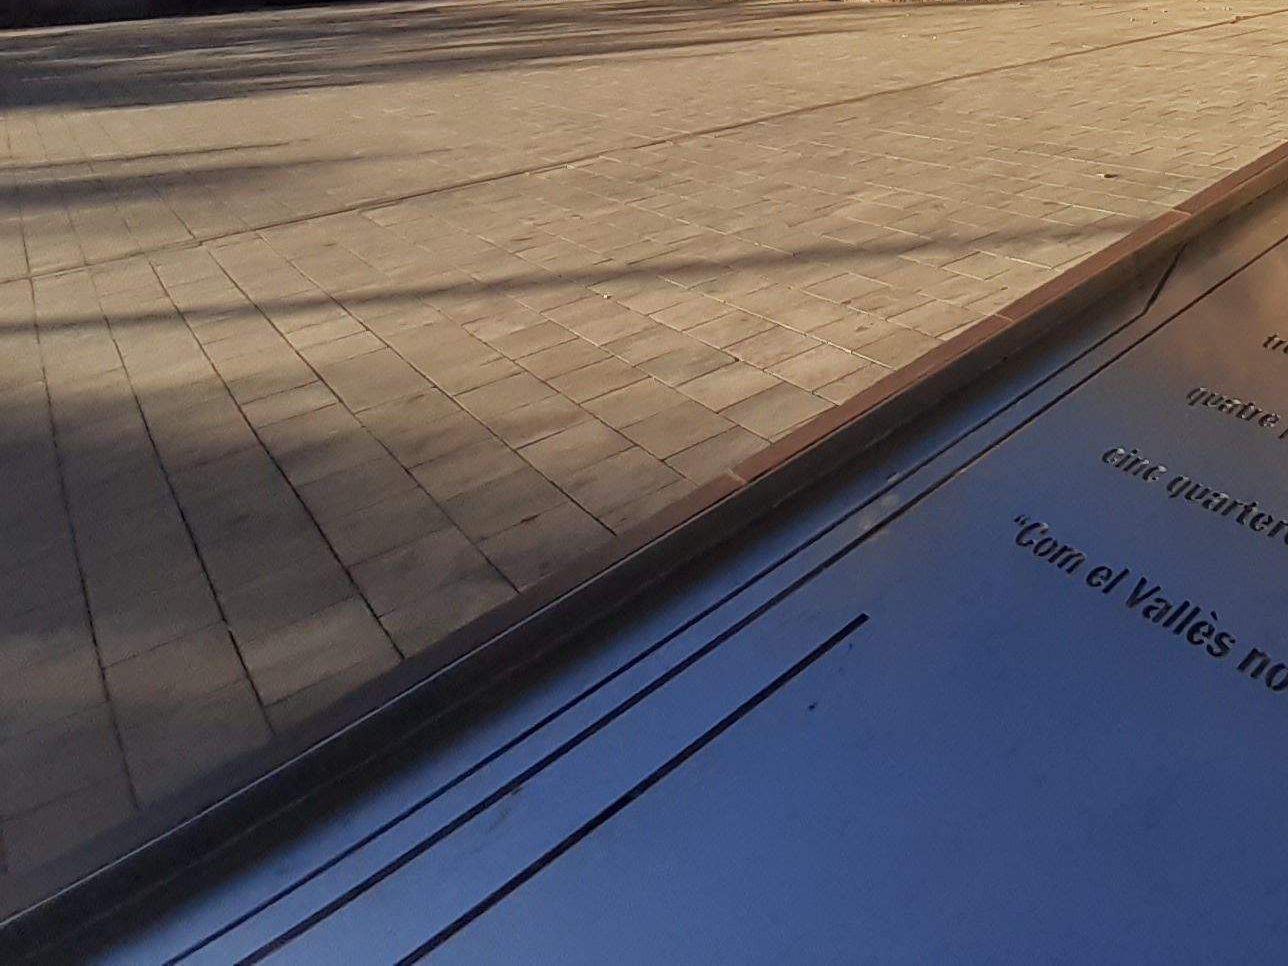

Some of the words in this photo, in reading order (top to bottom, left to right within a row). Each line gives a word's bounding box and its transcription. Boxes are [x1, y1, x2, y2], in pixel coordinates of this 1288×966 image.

[1185, 386, 1281, 430] quatre
[1101, 445, 1168, 483] cinc
[1086, 565, 1131, 594] el
[1125, 576, 1237, 658] Vallès
